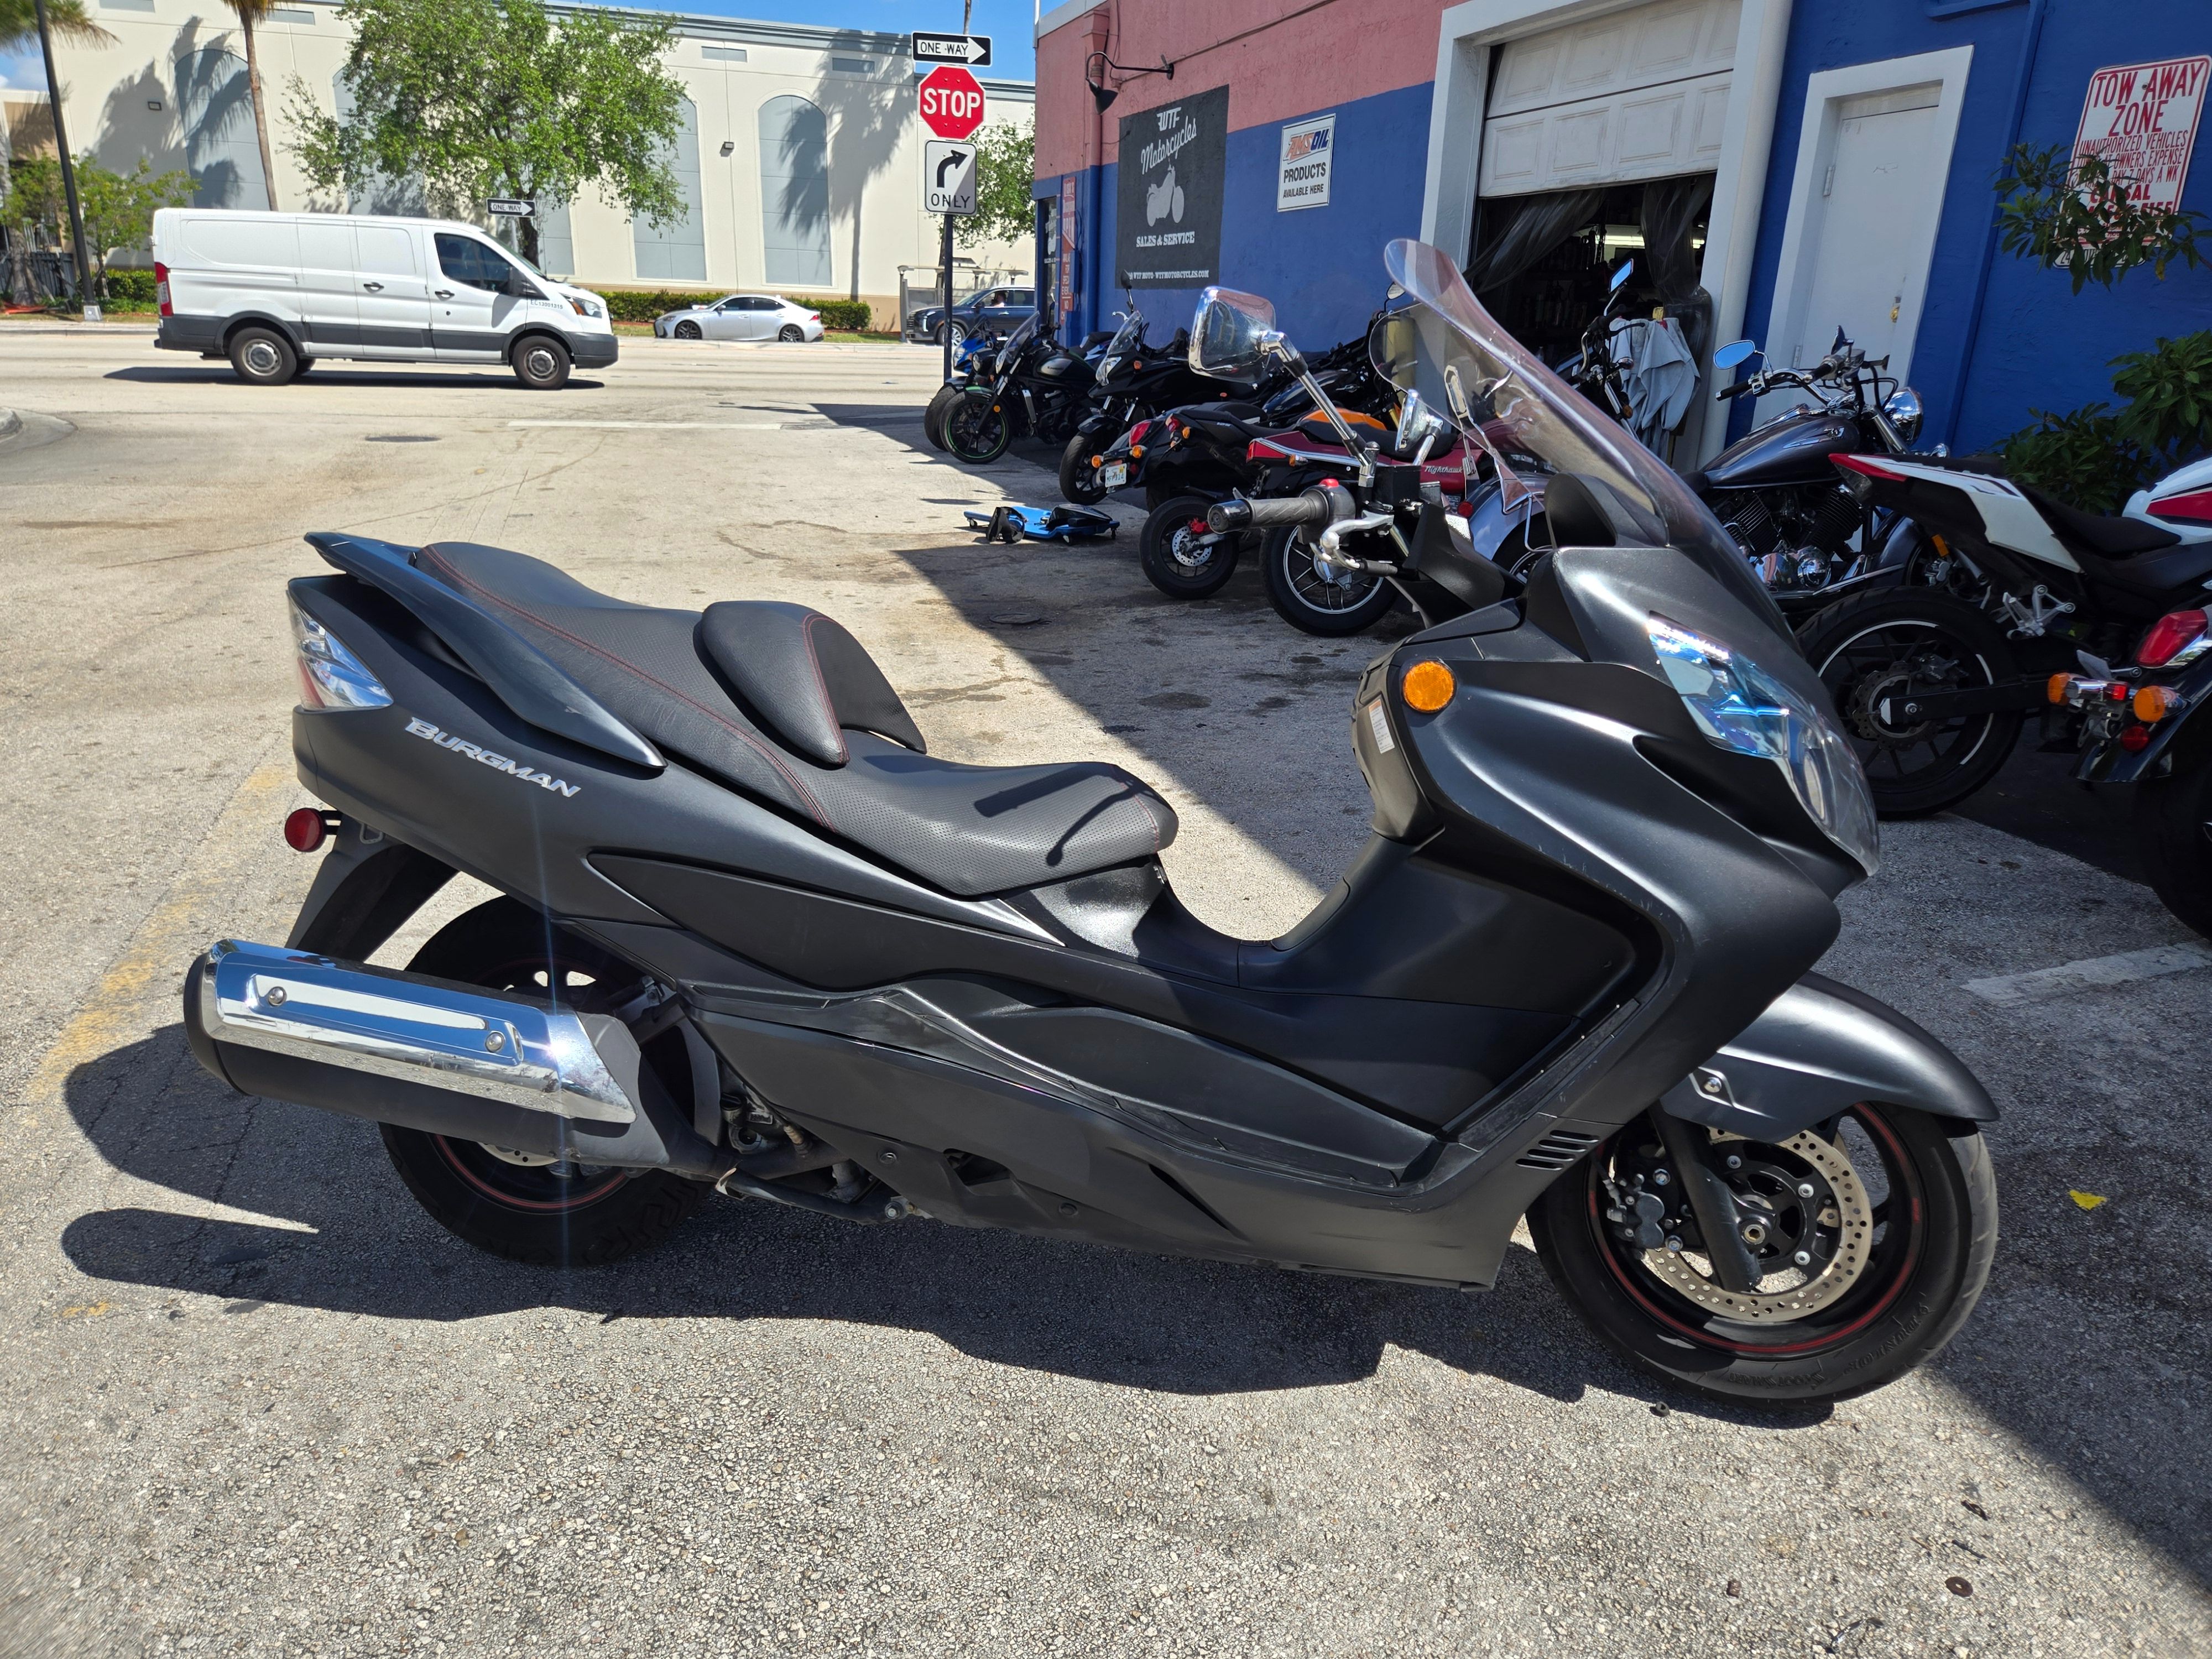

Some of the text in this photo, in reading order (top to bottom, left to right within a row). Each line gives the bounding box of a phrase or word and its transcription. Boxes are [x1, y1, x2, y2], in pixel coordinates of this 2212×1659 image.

[921, 41, 969, 55] ONE WAY
[2093, 61, 2205, 108] TOW AWAY
[923, 87, 981, 118] STOP
[1156, 106, 1182, 132] WTF
[2108, 100, 2169, 137] ZONE
[1141, 115, 1197, 175] Motorcycles
[1285, 129, 1329, 161] AMSOIL
[2080, 129, 2189, 155] UNAUTHORIZED VEHICLES
[2114, 150, 2147, 170] OWNERS
[2147, 148, 2185, 167] EXPENSE
[1284, 161, 1326, 184] PRODUCTS
[2135, 166, 2156, 185] DAYS
[2156, 166, 2163, 182] A
[2166, 165, 2180, 182] WK
[931, 193, 971, 209] ONLY
[1283, 184, 1324, 199] AVAILABLE HERE
[1136, 231, 1196, 248] SALES & SERVICE
[1425, 465, 1463, 474] Nighthawk
[404, 717, 582, 798] BURGMAN
